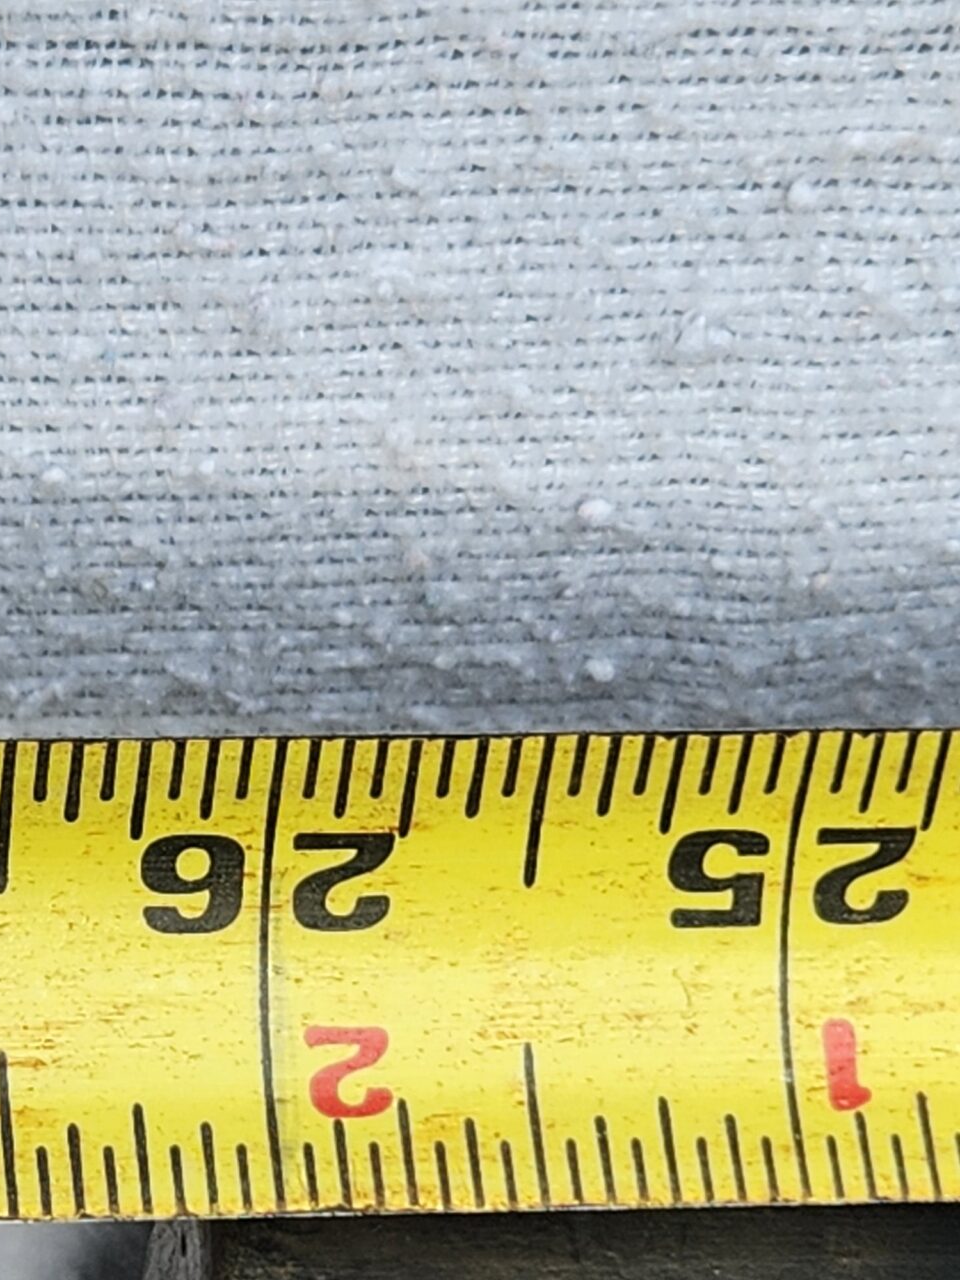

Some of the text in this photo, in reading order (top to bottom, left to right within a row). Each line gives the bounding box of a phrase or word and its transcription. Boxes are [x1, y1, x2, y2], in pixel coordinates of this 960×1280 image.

[140, 831, 396, 934] 26
[667, 827, 917, 928] 25
[304, 1026, 394, 1118] 2
[822, 1018, 872, 1112] 1
